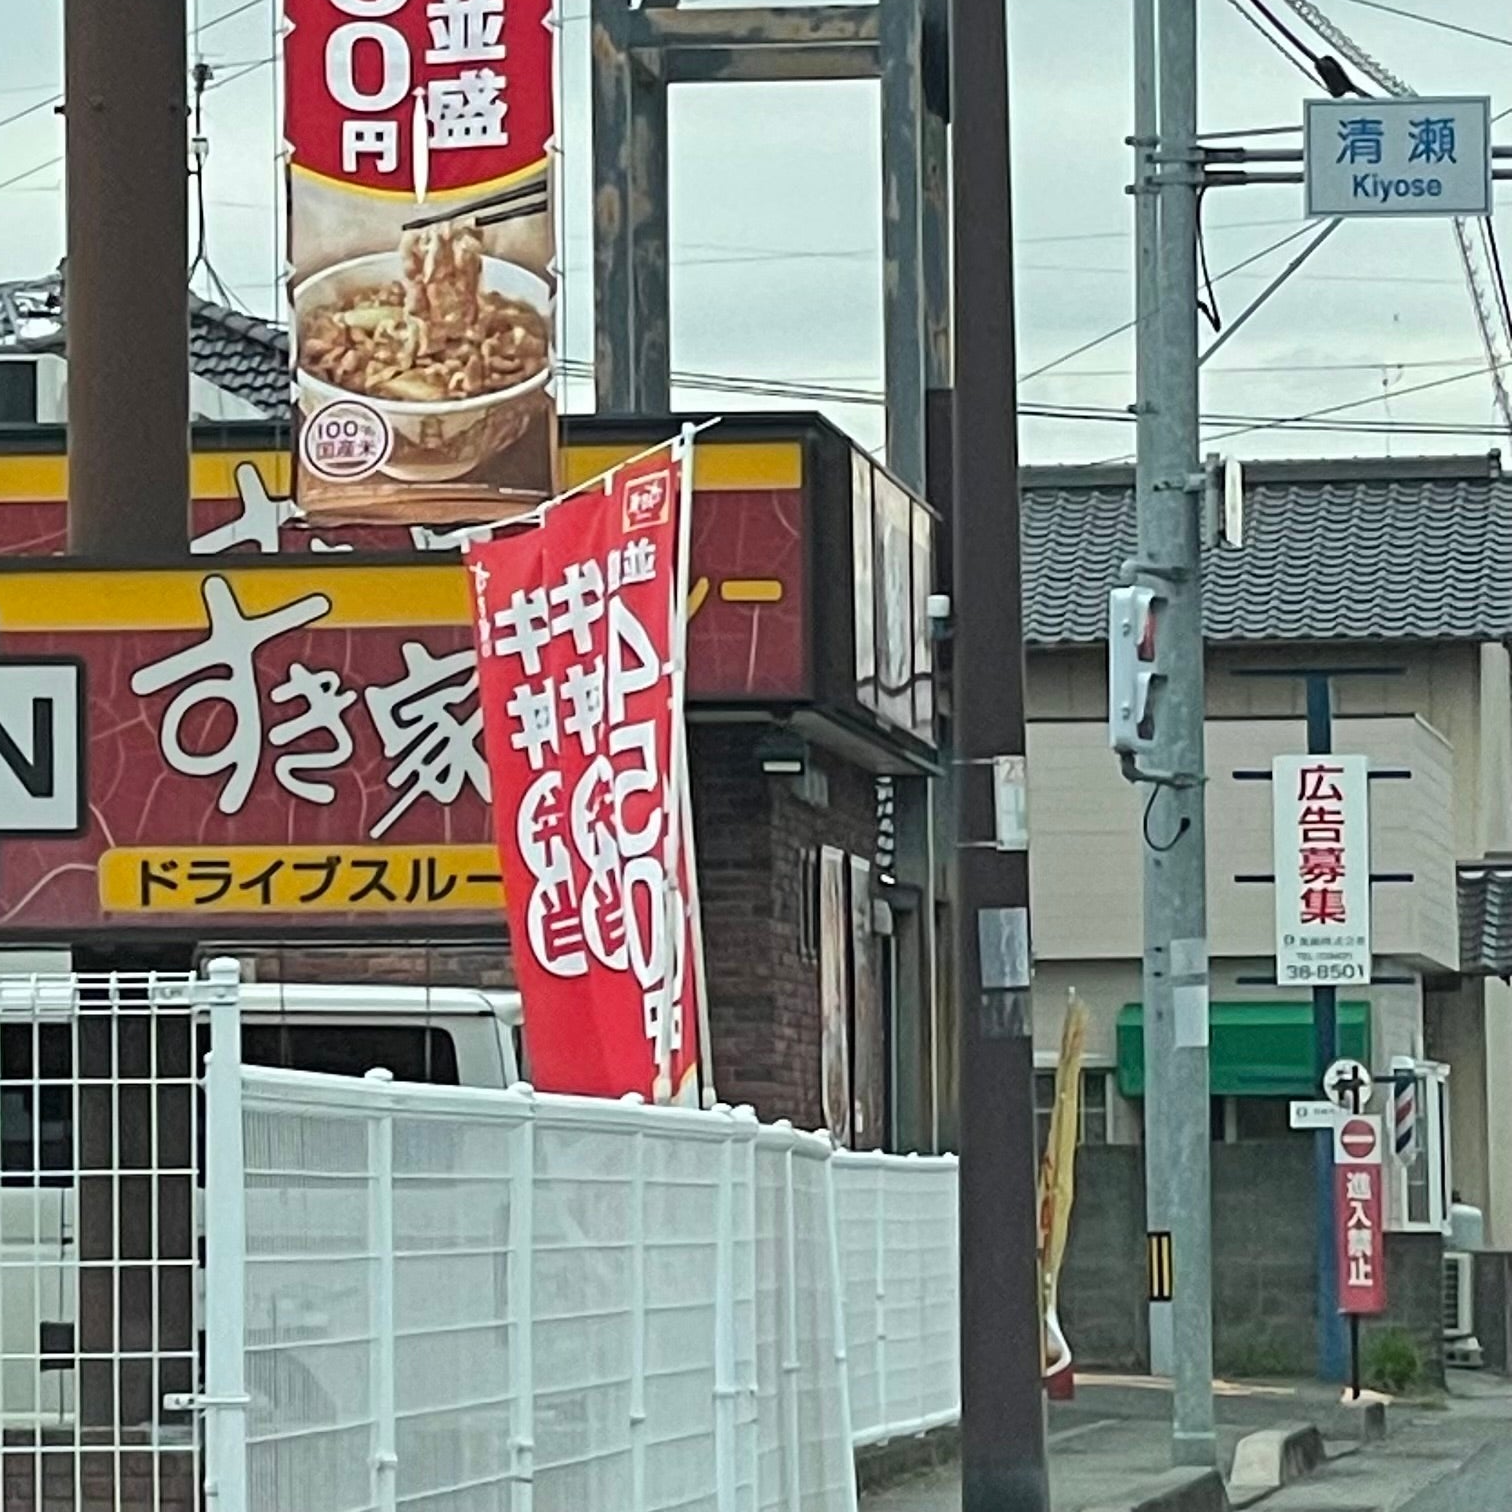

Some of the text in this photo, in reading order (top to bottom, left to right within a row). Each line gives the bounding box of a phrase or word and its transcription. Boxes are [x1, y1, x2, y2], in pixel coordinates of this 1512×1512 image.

[1352, 174, 1442, 202] Kiyose
[131, 574, 493, 839] すき家
[136, 857, 503, 906] ドライブスルー
[1297, 764, 1346, 925] 広告募集
[1346, 1172, 1374, 1286] 進入禁止
